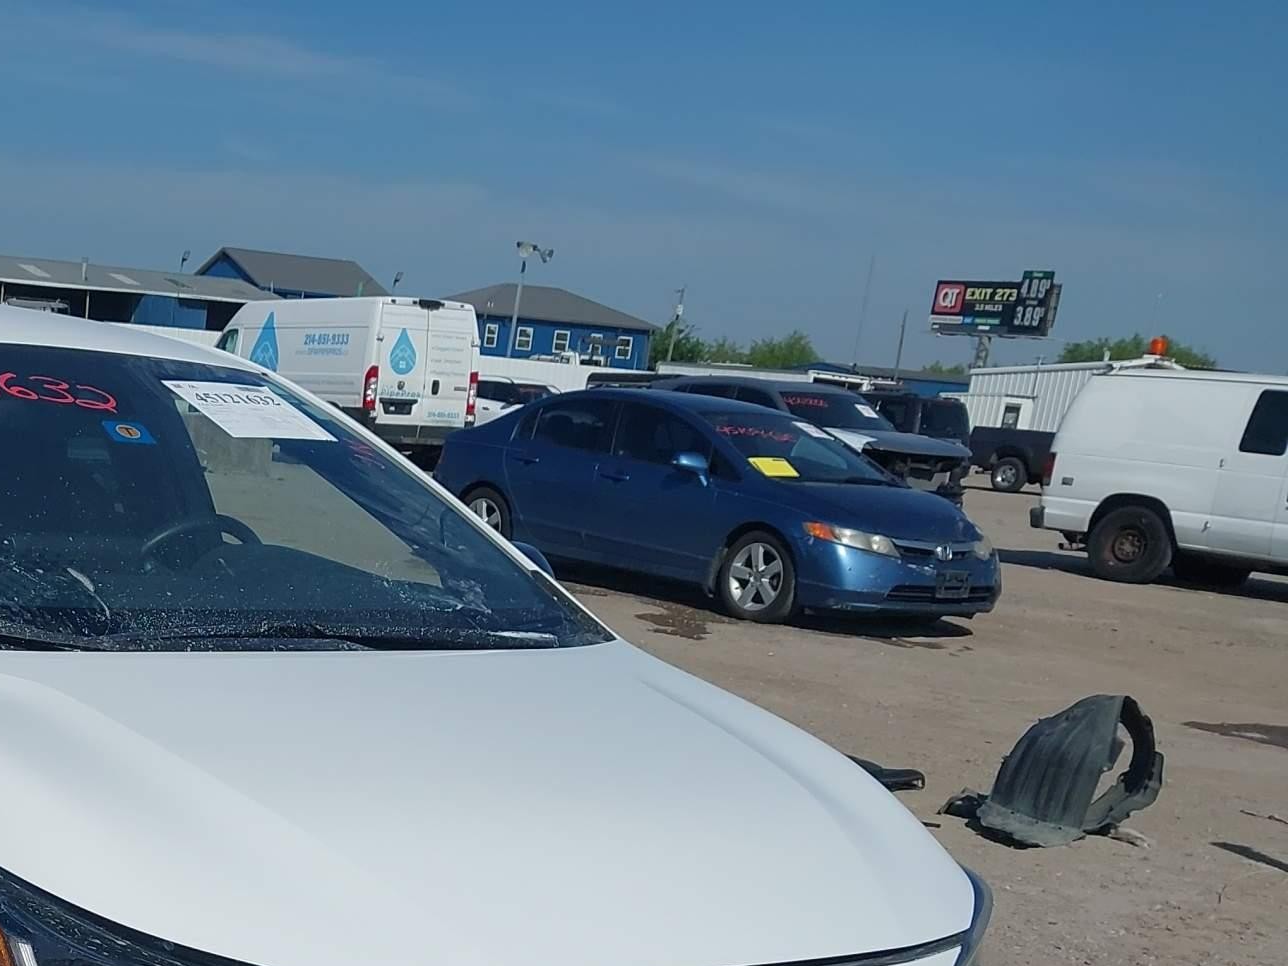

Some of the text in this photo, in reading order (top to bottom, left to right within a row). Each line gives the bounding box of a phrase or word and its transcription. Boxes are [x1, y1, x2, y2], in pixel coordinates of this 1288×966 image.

[939, 287, 961, 307] QT
[965, 287, 1018, 301] EXIT 273
[194, 392, 281, 406] 45121632
